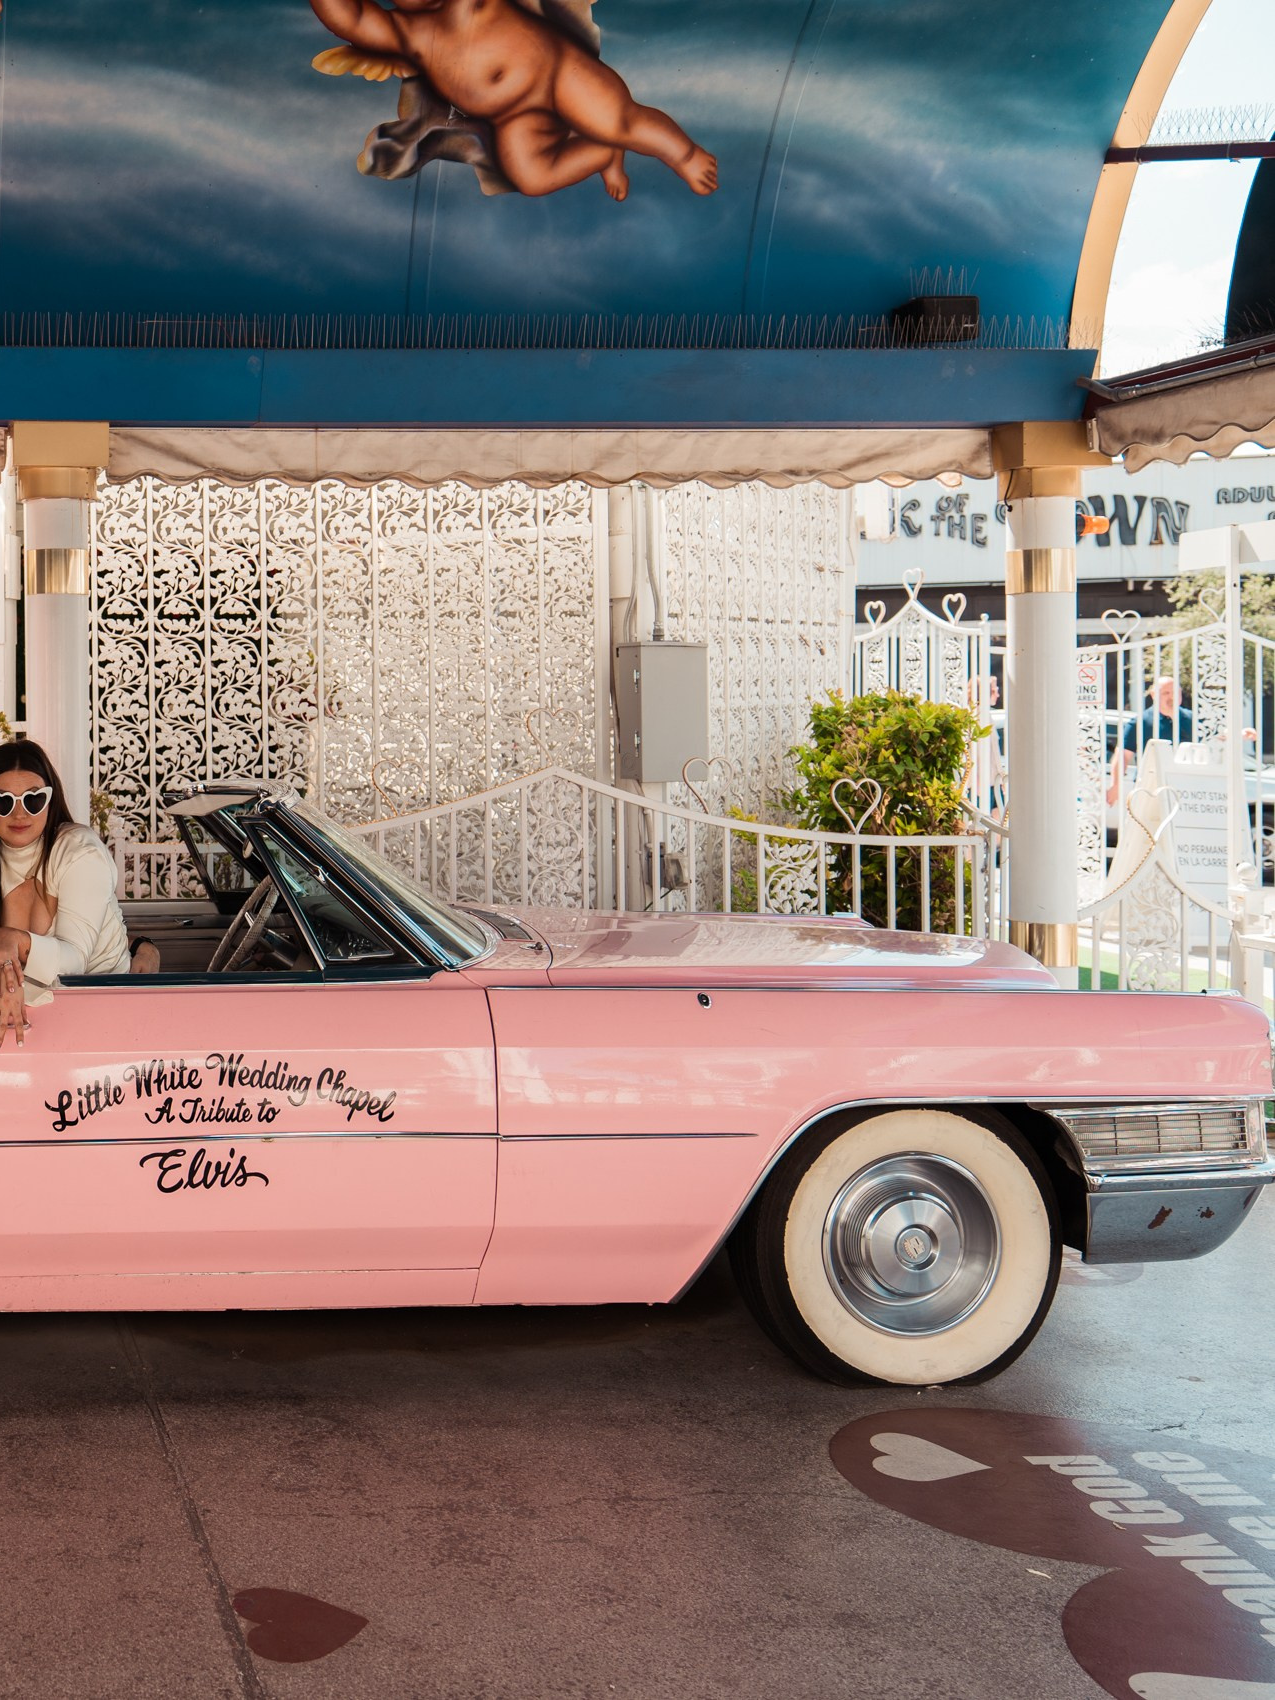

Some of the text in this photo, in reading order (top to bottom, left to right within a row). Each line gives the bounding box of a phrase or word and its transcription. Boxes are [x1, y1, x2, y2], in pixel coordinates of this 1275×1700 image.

[936, 493, 969, 514] OF
[1216, 486, 1275, 504] ADUL
[930, 513, 988, 548] THE
[1190, 790, 1207, 801] NOT
[1208, 791, 1228, 802] STAN
[1183, 803, 1199, 813] THE
[1200, 804, 1228, 815] DRIVE
[1177, 845, 1228, 856] NO PERMANE
[1179, 857, 1228, 868] EN LA CARRE
[44, 1052, 395, 1132] Little White Wedding Chapel
[145, 1097, 281, 1125] A Tribute to
[139, 1148, 269, 1193] Elvis
[1022, 1455, 1275, 1646] ank God
